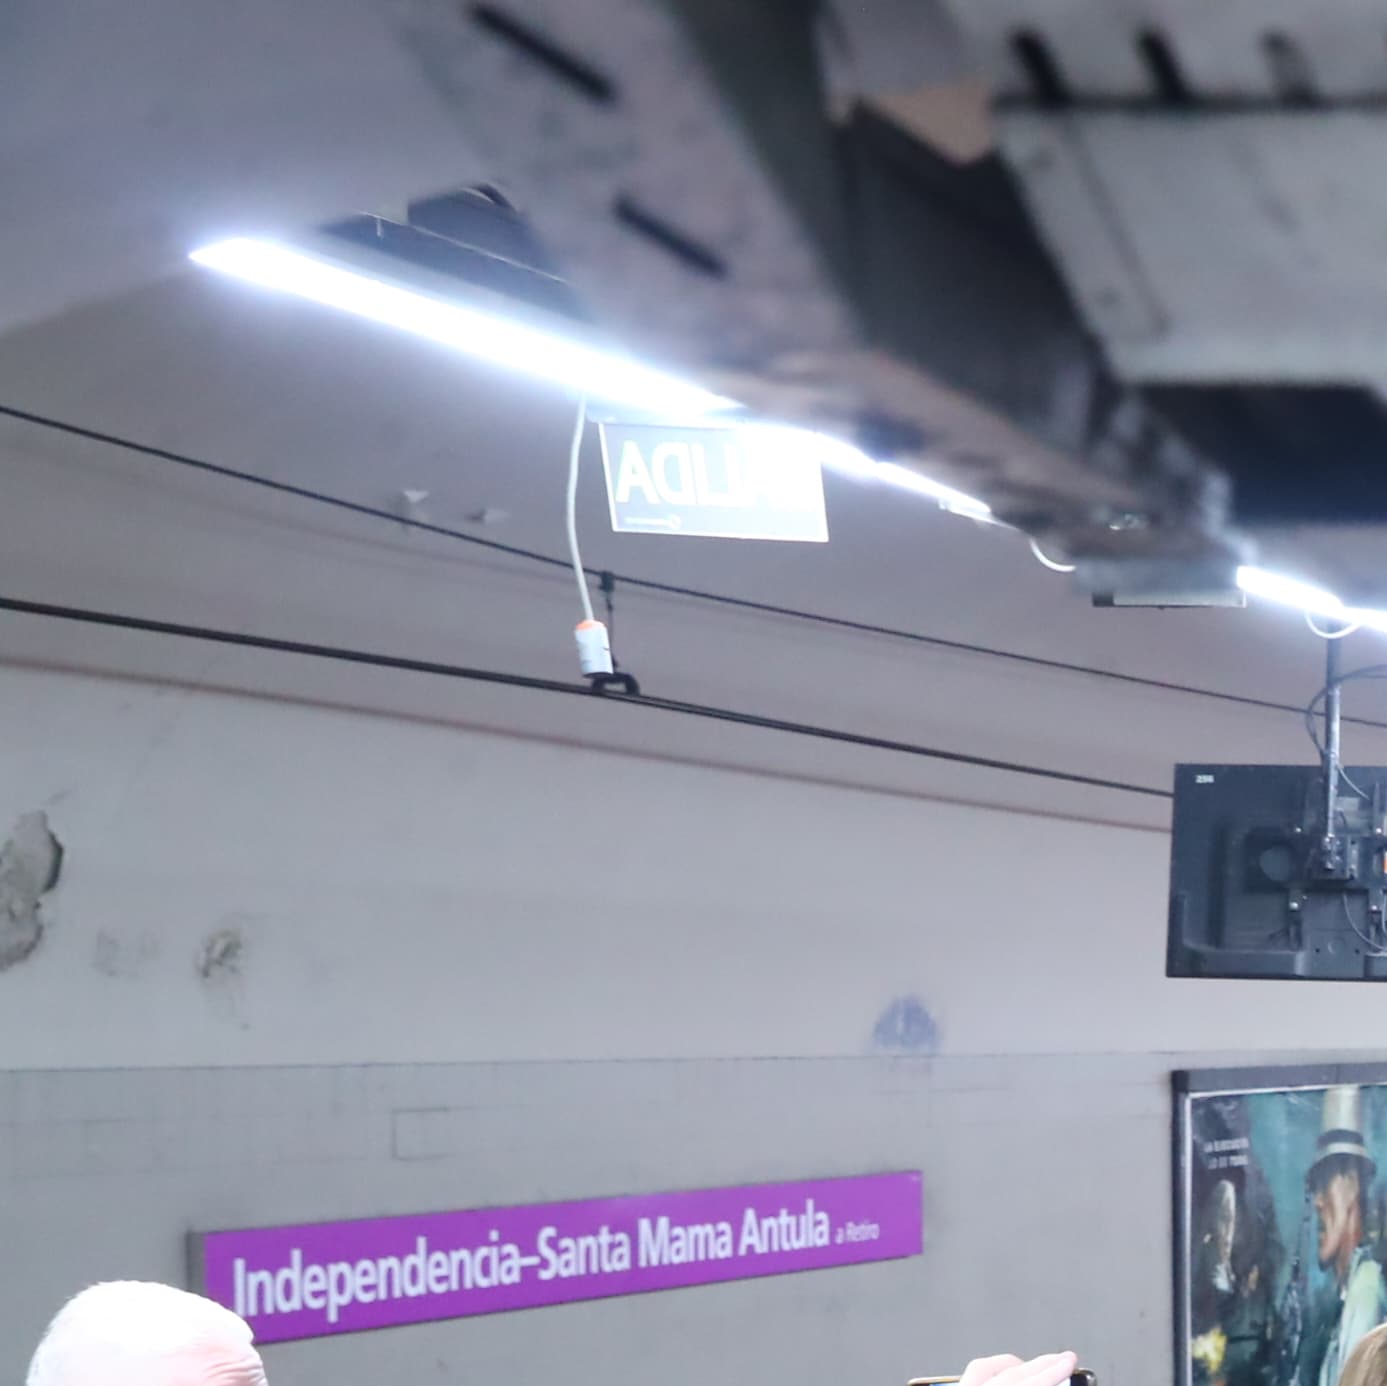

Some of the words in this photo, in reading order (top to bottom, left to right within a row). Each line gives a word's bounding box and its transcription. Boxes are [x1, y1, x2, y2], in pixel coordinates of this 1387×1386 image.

[638, 1216, 733, 1268] Mama
[739, 1199, 830, 1256] Antula
[835, 1228, 845, 1245] a
[846, 1220, 880, 1243] Retiro
